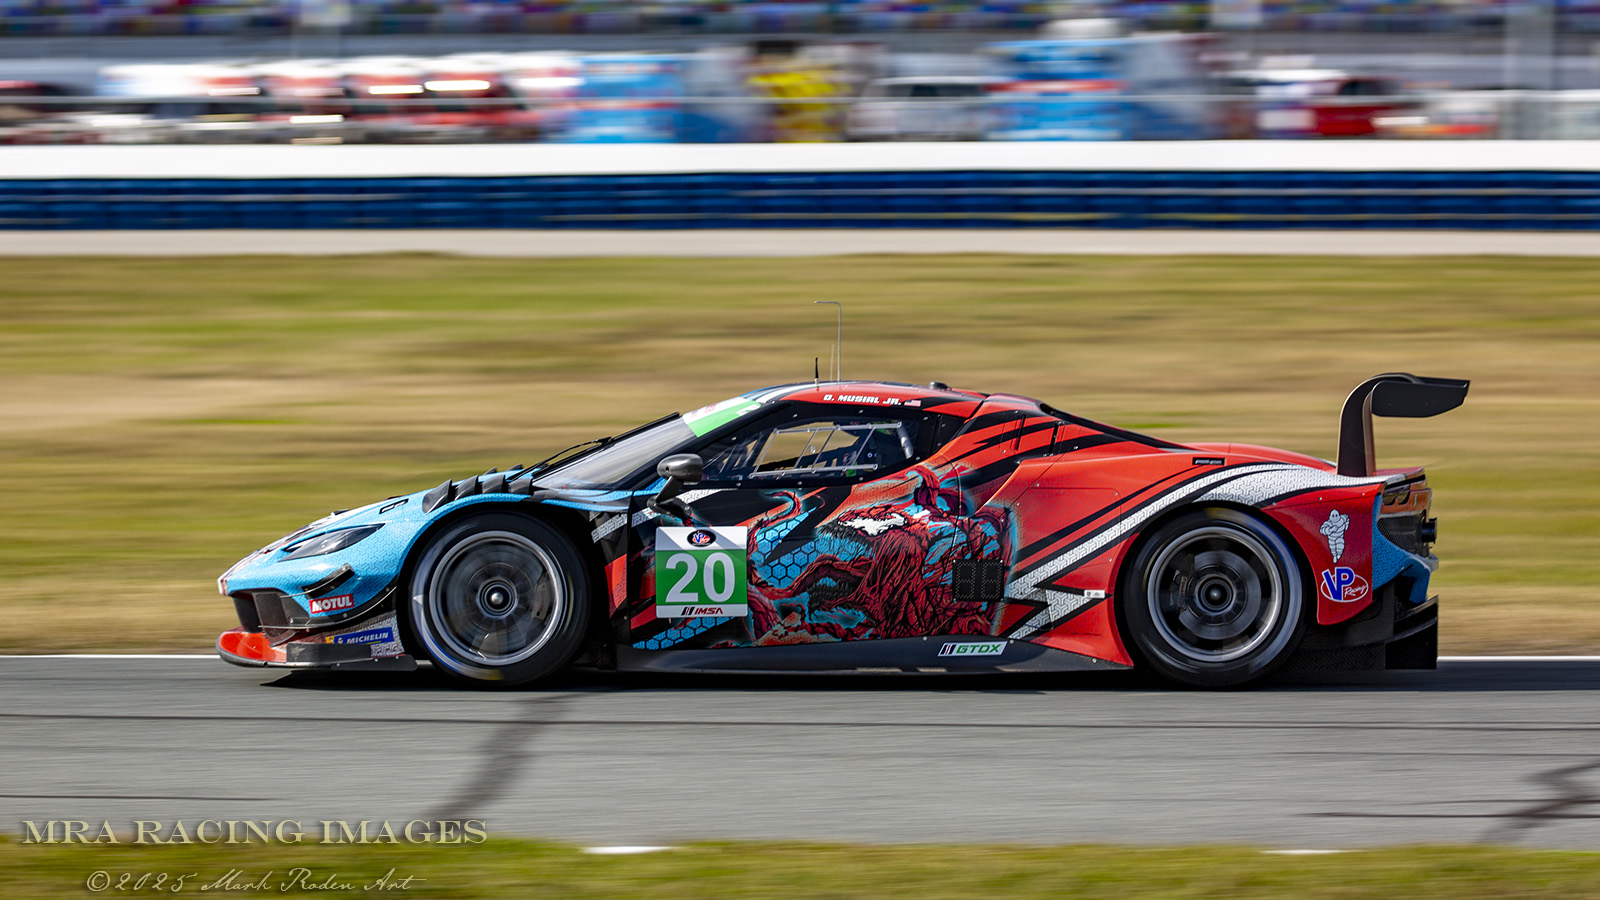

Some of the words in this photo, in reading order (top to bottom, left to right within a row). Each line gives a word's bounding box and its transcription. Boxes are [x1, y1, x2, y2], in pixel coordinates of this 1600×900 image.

[837, 395, 880, 404] MUSIAL
[882, 397, 902, 405] JR.
[665, 552, 735, 603] 20
[1321, 566, 1355, 601] VP
[1344, 585, 1367, 598] Racing
[312, 596, 353, 613] MOTUL
[694, 607, 723, 615] IMSA
[346, 632, 389, 644] MICHELIN
[956, 644, 1002, 654] GTDX
